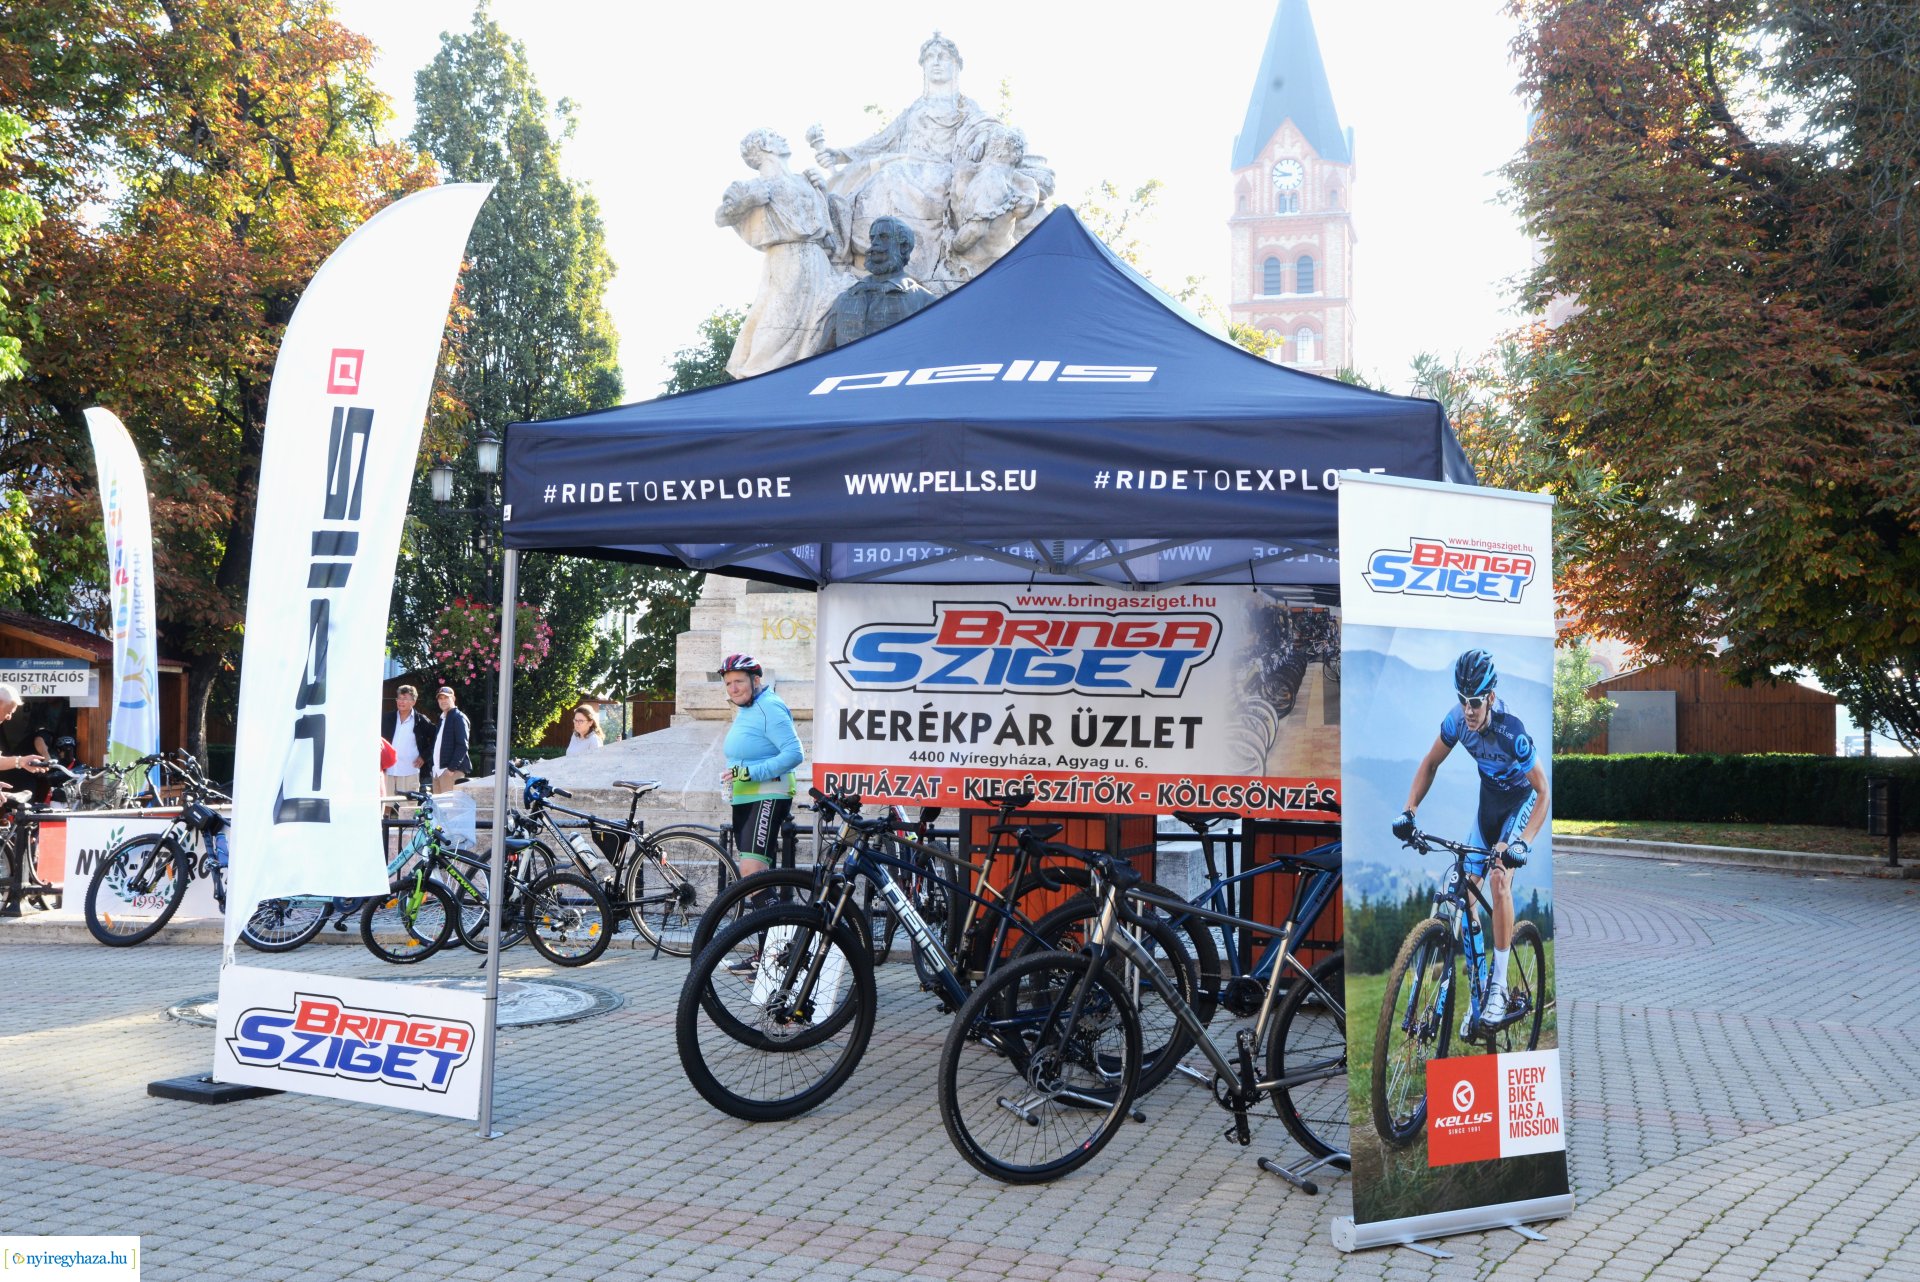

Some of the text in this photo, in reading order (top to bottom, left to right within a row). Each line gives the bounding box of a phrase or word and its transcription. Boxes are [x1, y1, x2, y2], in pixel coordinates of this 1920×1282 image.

[543, 476, 793, 504] #RIDETOEXPLORE
[844, 469, 1038, 495] WWW.PELLS.EU
[1093, 467, 1386, 492] #RIDETOEXPLO
[1448, 537, 1534, 553] www.bringasziget.hu
[1411, 543, 1532, 576] BRINGA
[1371, 554, 1529, 598] SZIGET
[1015, 593, 1217, 611] www.bringasziget.hu
[762, 616, 817, 641] KOS
[936, 610, 1213, 653] BRINGA
[848, 632, 1204, 689] SZIGET
[838, 703, 1203, 750] KERÉKPÁR ÜZLET
[908, 750, 1149, 770] 4400 Nyíregyháza, Agyag u. 6.
[823, 769, 942, 800] RUHÁZAT
[963, 773, 1134, 806] KIEGÉSZÍTŐK
[1156, 778, 1337, 811] KÖLCSÖNZÉS
[294, 1000, 469, 1052] BRINGA
[237, 1015, 462, 1085] SZIGET
[1507, 1066, 1546, 1085] EVERY
[1508, 1085, 1536, 1103] BIKE
[1434, 1111, 1493, 1129] KELLYS
[1508, 1102, 1545, 1121] HAS A
[1509, 1117, 1559, 1139] MISSION
